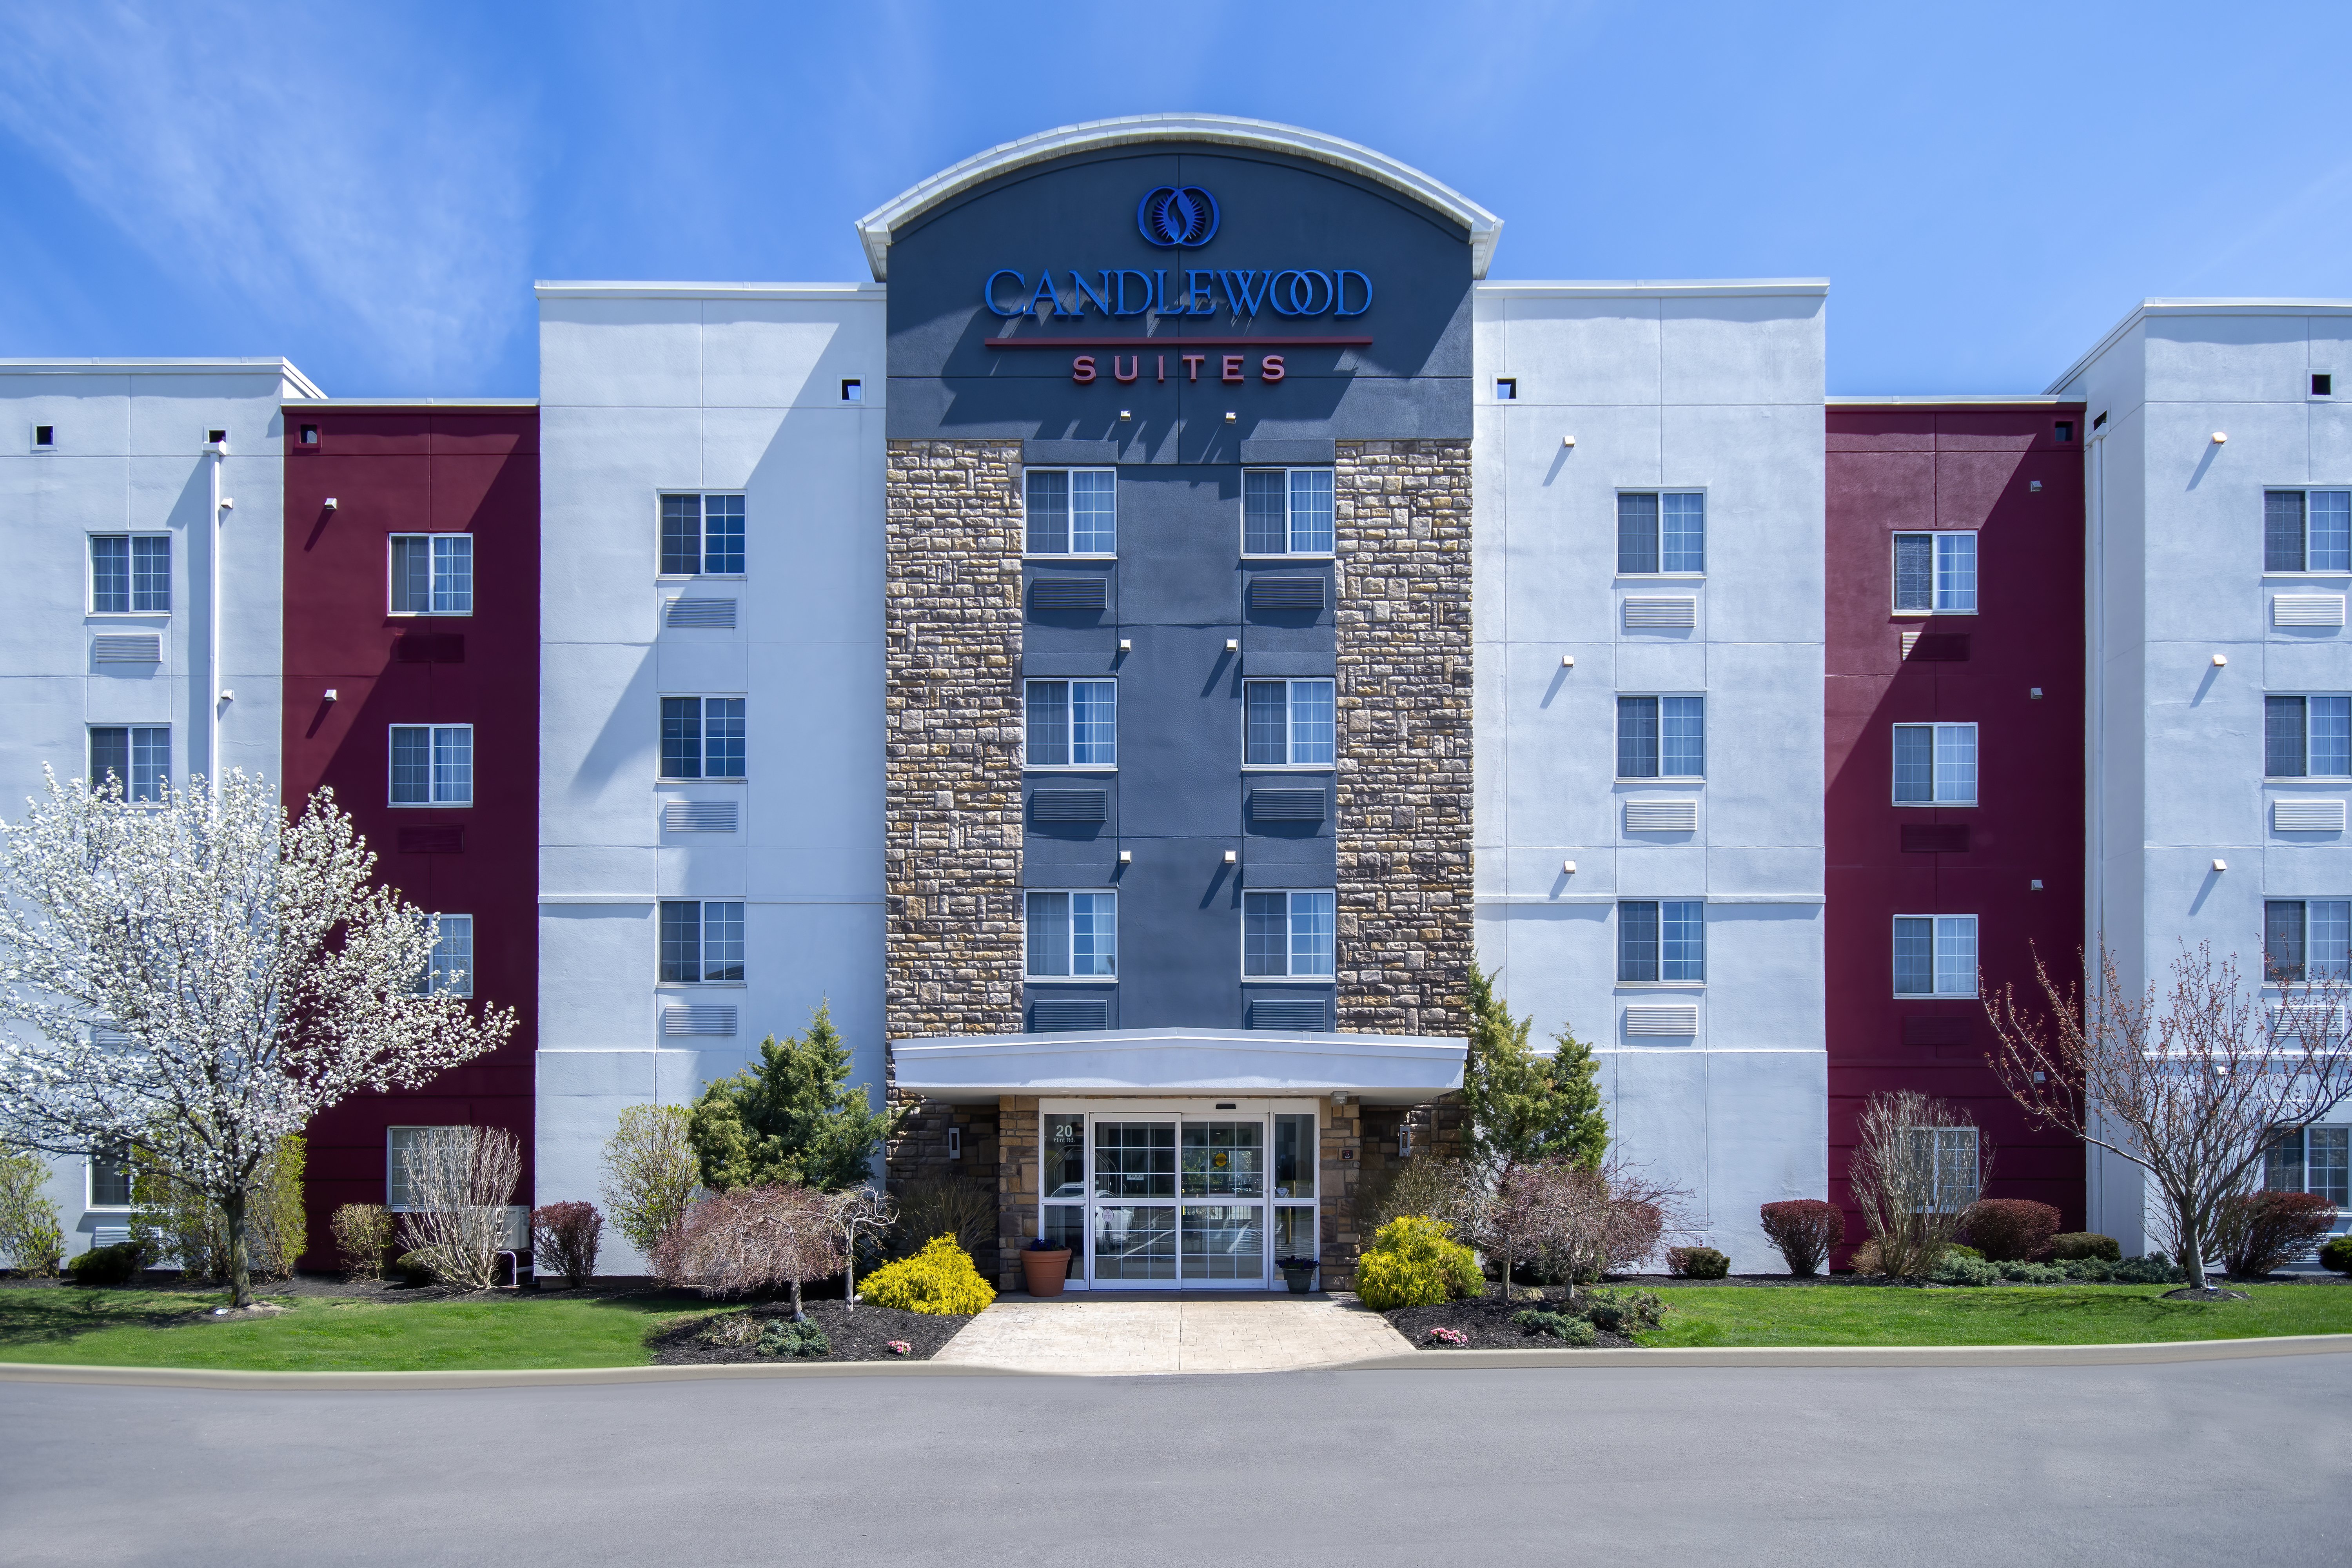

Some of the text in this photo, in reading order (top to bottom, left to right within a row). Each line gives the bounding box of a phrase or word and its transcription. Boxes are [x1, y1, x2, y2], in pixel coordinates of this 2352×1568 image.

[985, 268, 1372, 316] CANDLEWOOD
[1073, 355, 1285, 383] SUITES
[1056, 1125, 1073, 1137] 20
